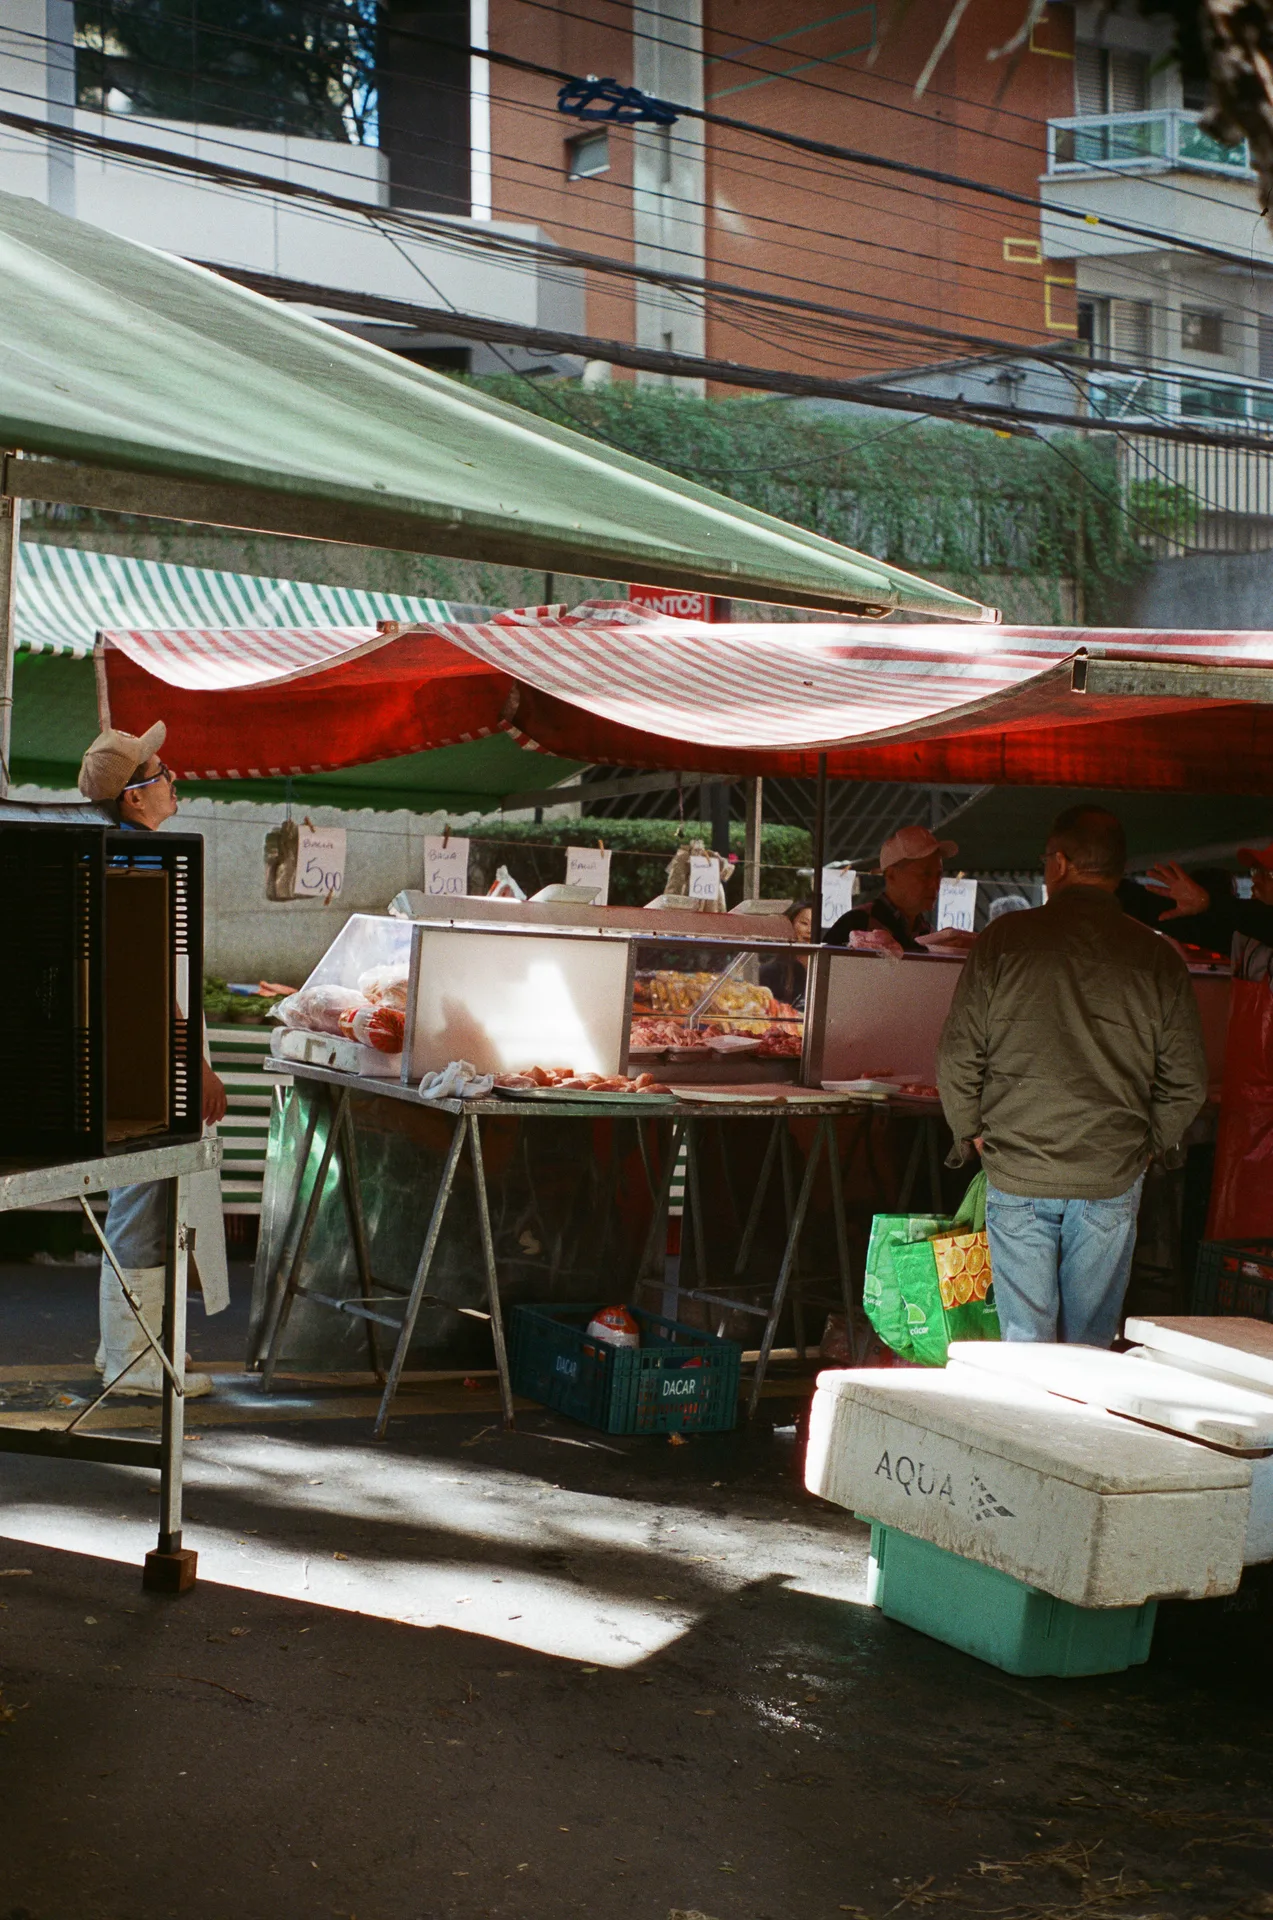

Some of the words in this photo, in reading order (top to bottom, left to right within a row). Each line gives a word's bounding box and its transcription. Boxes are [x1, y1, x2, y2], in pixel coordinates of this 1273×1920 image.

[301, 857, 342, 893] 5,00
[556, 1355, 577, 1378] DACAR
[662, 1379, 697, 1396] DACAR
[874, 1450, 956, 1506] AQUA
